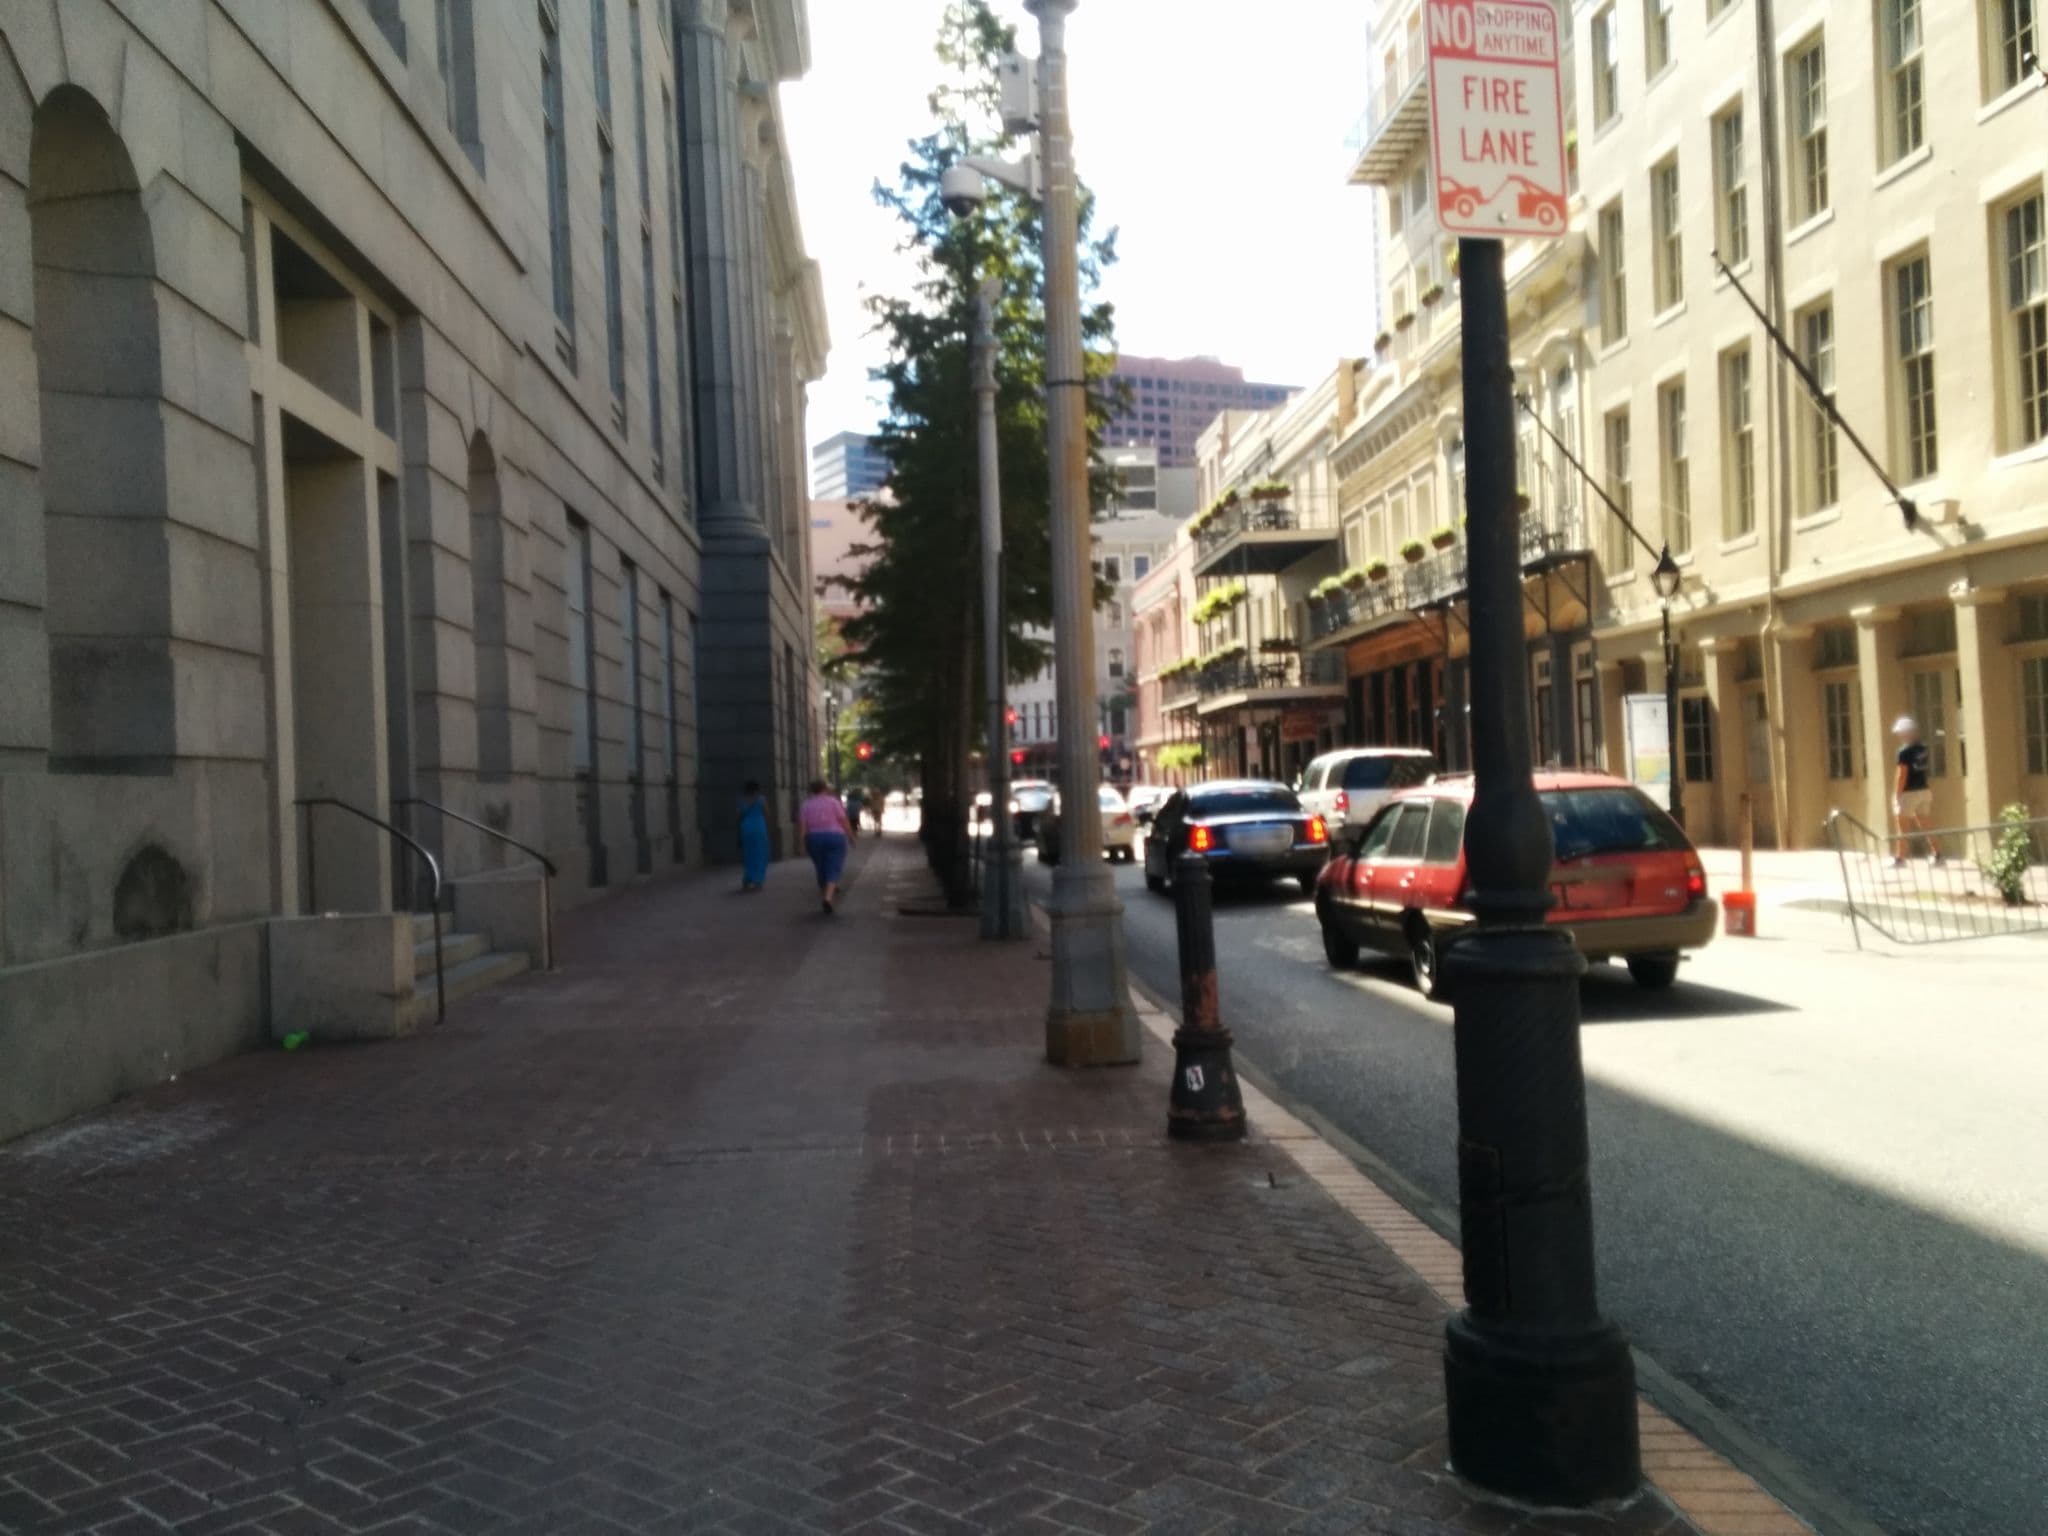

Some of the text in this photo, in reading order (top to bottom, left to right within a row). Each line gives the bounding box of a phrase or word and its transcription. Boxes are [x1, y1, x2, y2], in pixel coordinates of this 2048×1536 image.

[1430, 2, 1553, 50] NO STOPPING
[1483, 31, 1547, 56] ANYTIME
[1463, 75, 1529, 115] FIRE
[1461, 125, 1538, 166] LANE
